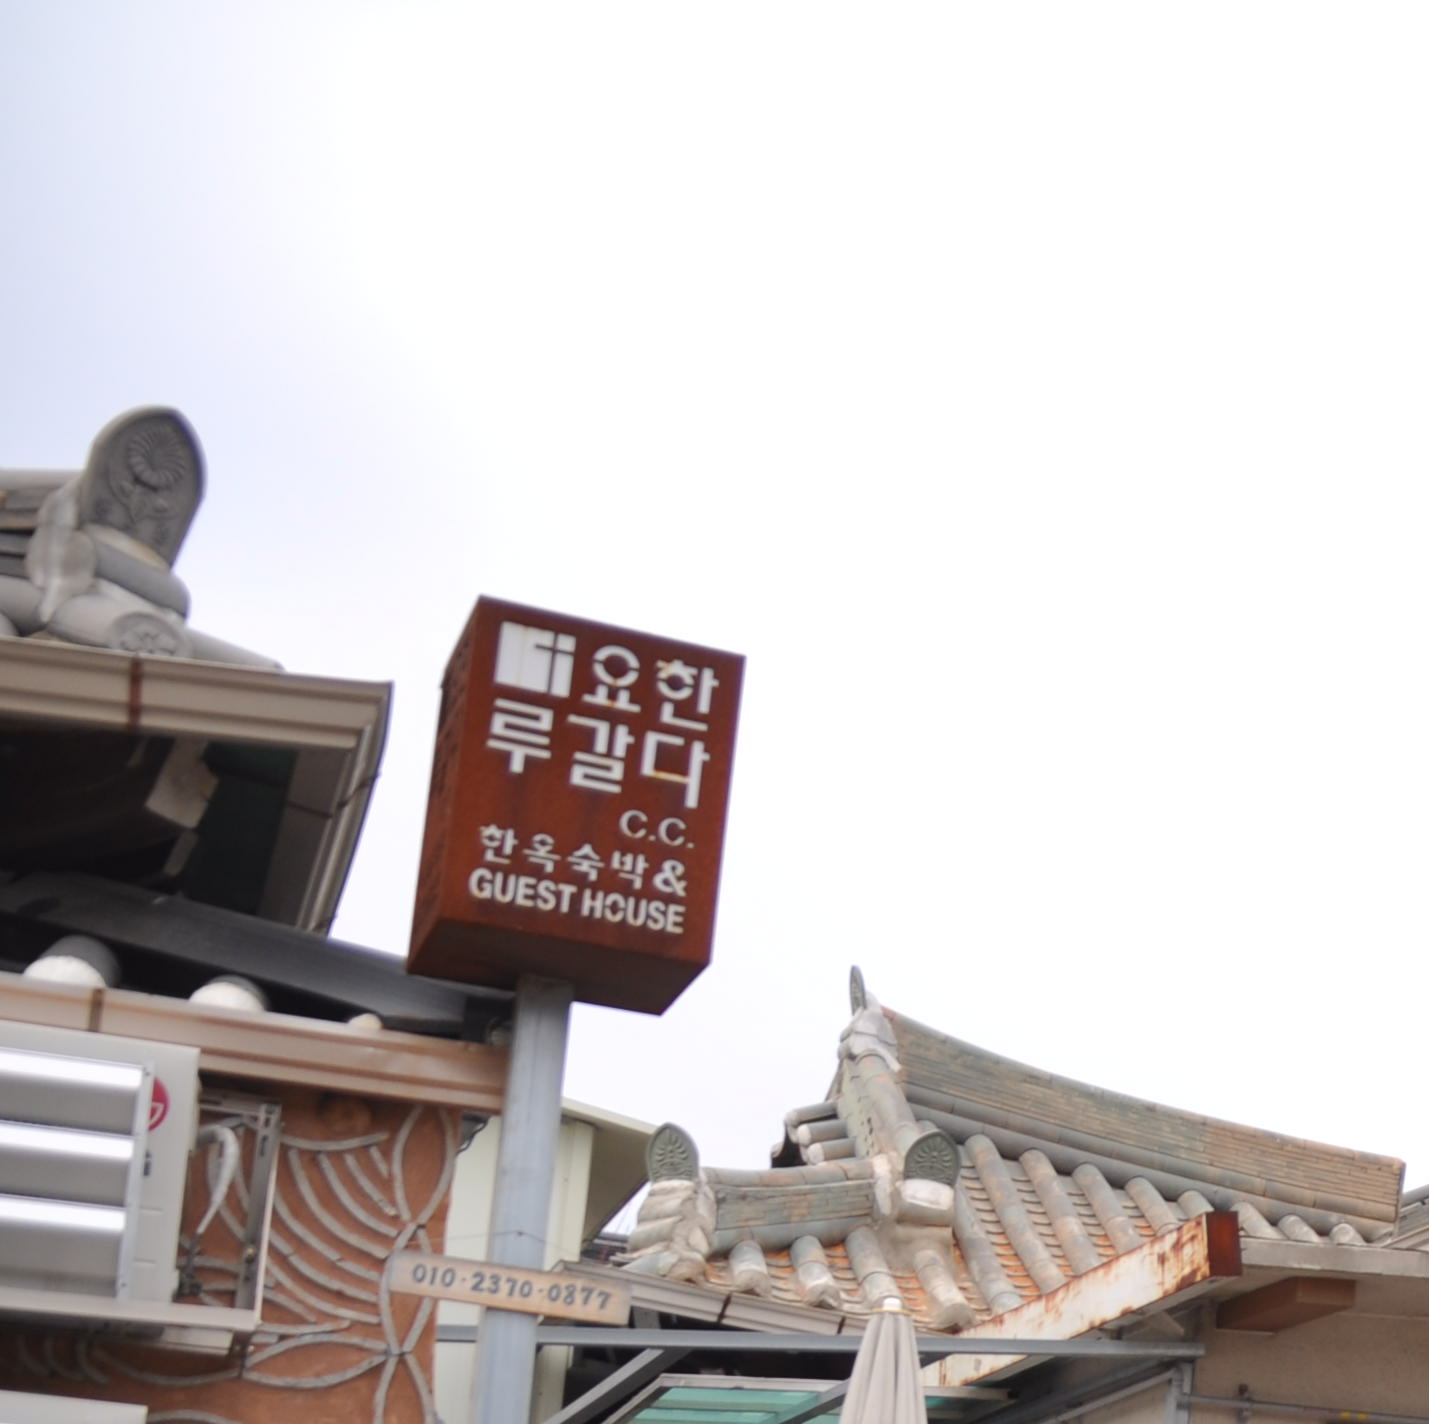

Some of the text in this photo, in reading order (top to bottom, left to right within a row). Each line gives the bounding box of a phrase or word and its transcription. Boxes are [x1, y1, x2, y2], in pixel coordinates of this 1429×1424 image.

[582, 644, 719, 732] 요한
[486, 698, 710, 809] 루갈다
[479, 823, 688, 897] 한옥숙박 &
[619, 809, 695, 850] C.C.
[468, 867, 686, 934] GUEST HOUSE
